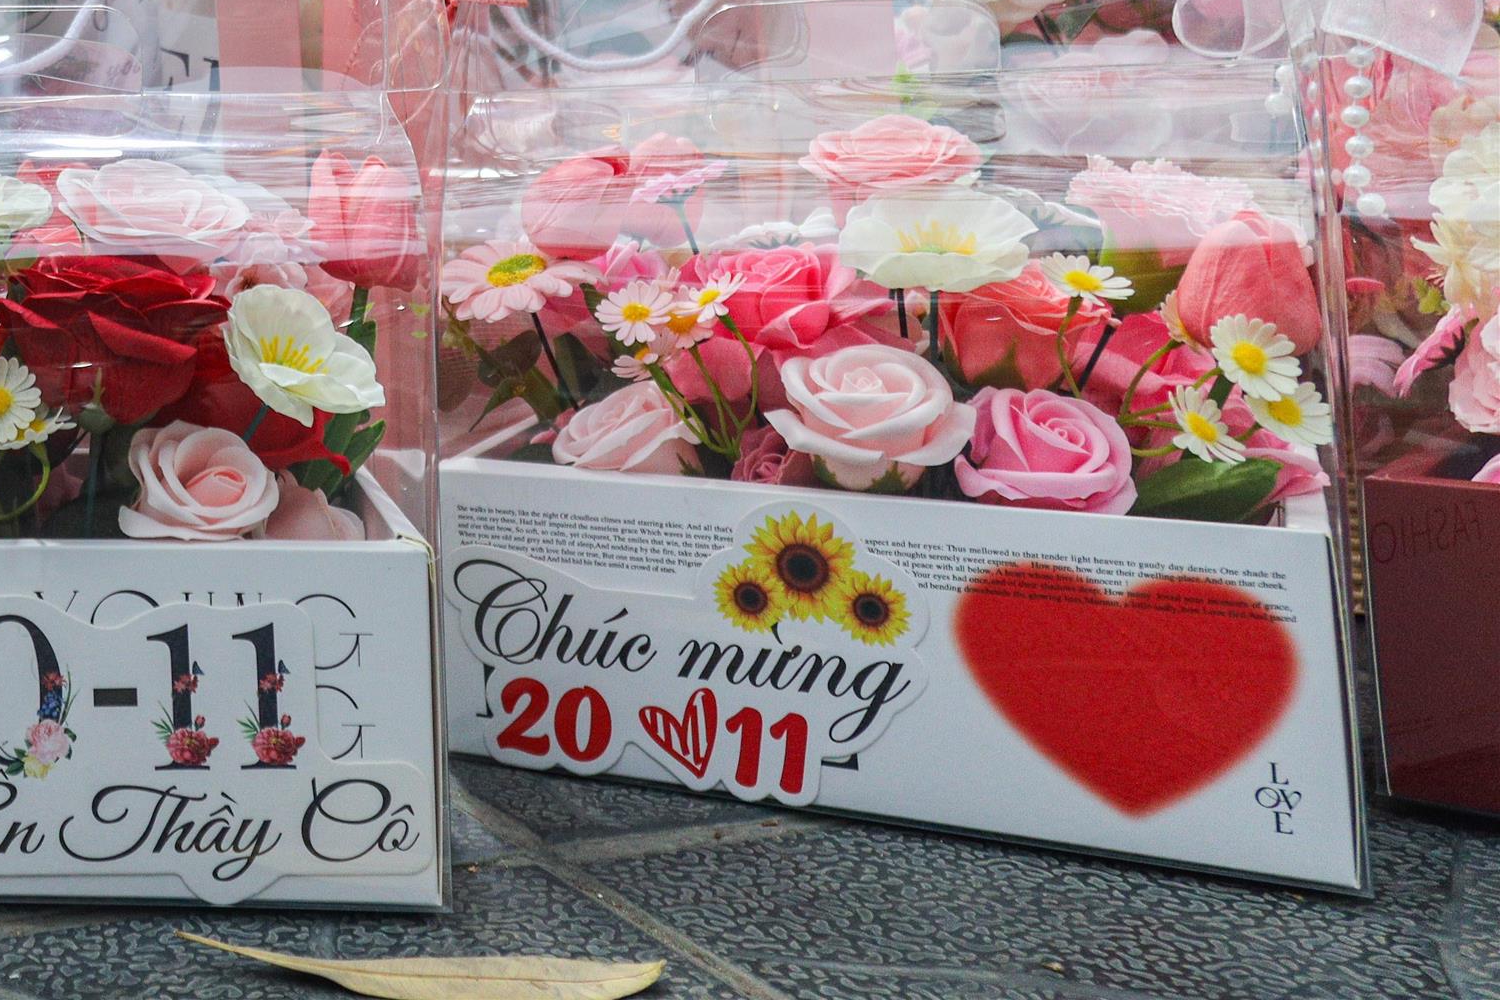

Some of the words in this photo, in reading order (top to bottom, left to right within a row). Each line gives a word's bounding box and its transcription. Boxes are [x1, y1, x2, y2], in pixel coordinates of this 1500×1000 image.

[864, 538, 889, 549] aspect
[891, 540, 906, 548] and
[908, 541, 920, 549] her
[948, 545, 966, 553] Thus
[969, 546, 1010, 556] mellowed
[1022, 551, 1039, 559] that
[1041, 552, 1068, 561] tender
[1071, 554, 1091, 565] light
[1093, 556, 1124, 566] heaven
[1187, 564, 1217, 573] denies
[1219, 566, 1239, 575] One
[1242, 568, 1269, 577] shade
[1271, 570, 1286, 578] the
[454, 559, 657, 664] Chúc
[678, 620, 911, 743] mừng
[496, 676, 612, 762] 20
[724, 705, 809, 794] 11
[58, 782, 283, 882] Thầy
[300, 777, 422, 863] Cô
